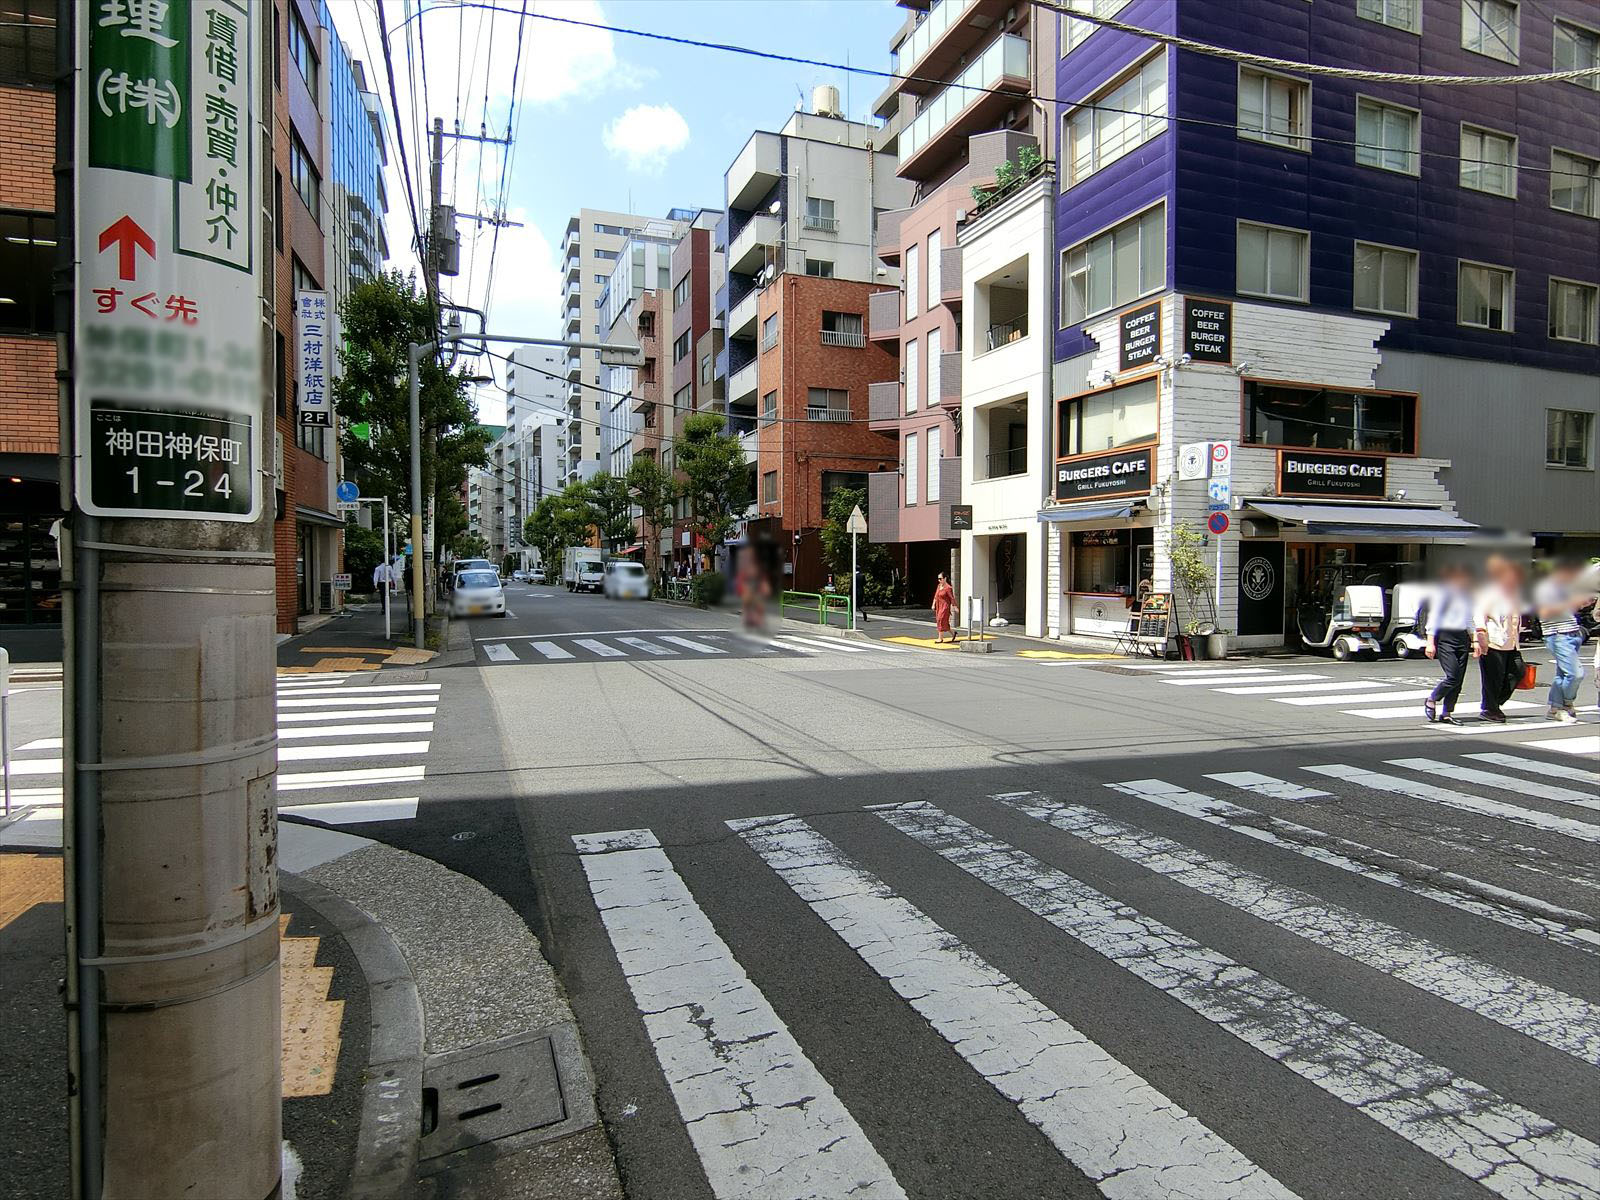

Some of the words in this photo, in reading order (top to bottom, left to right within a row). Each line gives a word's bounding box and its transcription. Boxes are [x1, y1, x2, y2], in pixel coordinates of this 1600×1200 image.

[205, 8, 239, 251] 賃借・売買・仲介
[92, 287, 199, 326] すぐ先
[1191, 308, 1225, 320] COFFEE
[1125, 312, 1156, 329] COFFEE
[1196, 320, 1220, 331] BEER
[1130, 325, 1151, 339] BEER
[1190, 331, 1225, 343] BURGER
[1125, 334, 1156, 351] BURGER
[1194, 343, 1222, 354] STEAK
[1127, 346, 1153, 361] STEAK
[303, 324, 326, 405] 三村洋紙店
[96, 414, 122, 422] ここは
[303, 412, 325, 422] 2F
[105, 427, 242, 465] 神田神保町
[1215, 448, 1225, 457] 30
[1058, 465, 1111, 482] BURGERS
[1112, 460, 1146, 475] CAFE
[1287, 460, 1347, 476] BURGERS
[1349, 463, 1383, 478] CAFE
[126, 466, 232, 499] 1-24
[1077, 483, 1093, 491] GRILL
[1094, 479, 1126, 488] FUKUYOSHI
